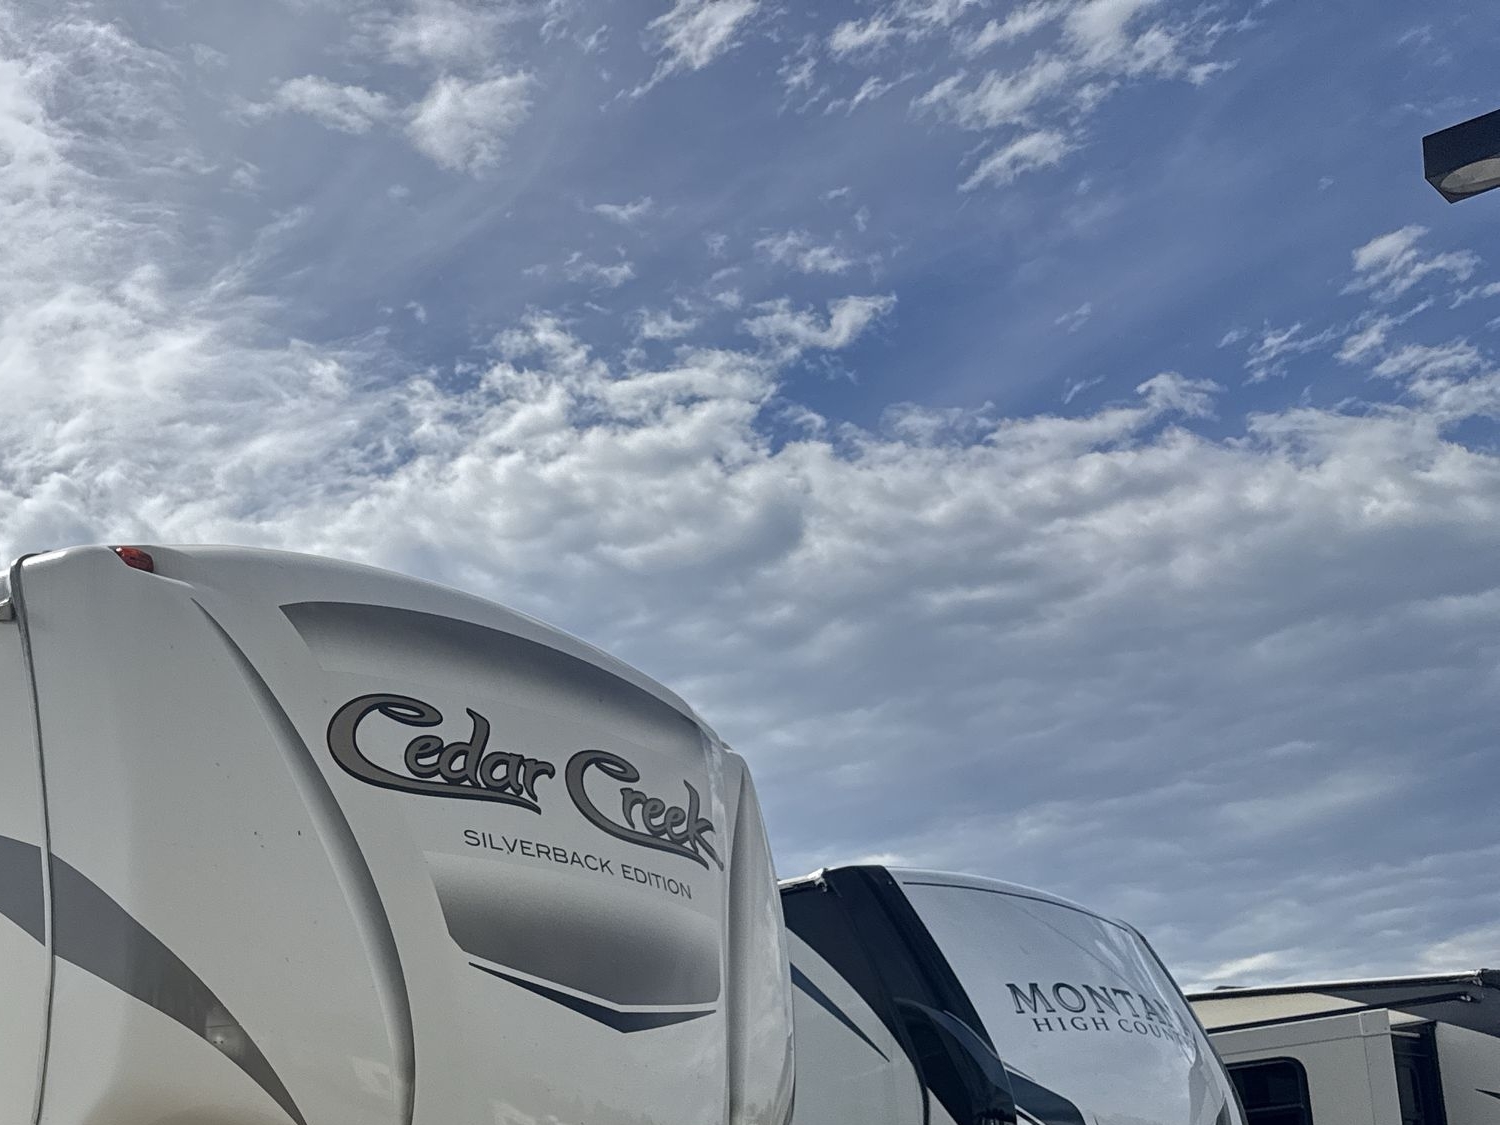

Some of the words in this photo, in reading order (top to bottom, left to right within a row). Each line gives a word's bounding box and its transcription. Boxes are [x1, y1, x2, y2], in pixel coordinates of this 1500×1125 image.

[326, 693, 556, 816] Cedar
[564, 749, 725, 872] Creek
[463, 829, 615, 876] SILVERBACK
[621, 863, 692, 899] EDITION
[1031, 1016, 1110, 1032] HIGH
